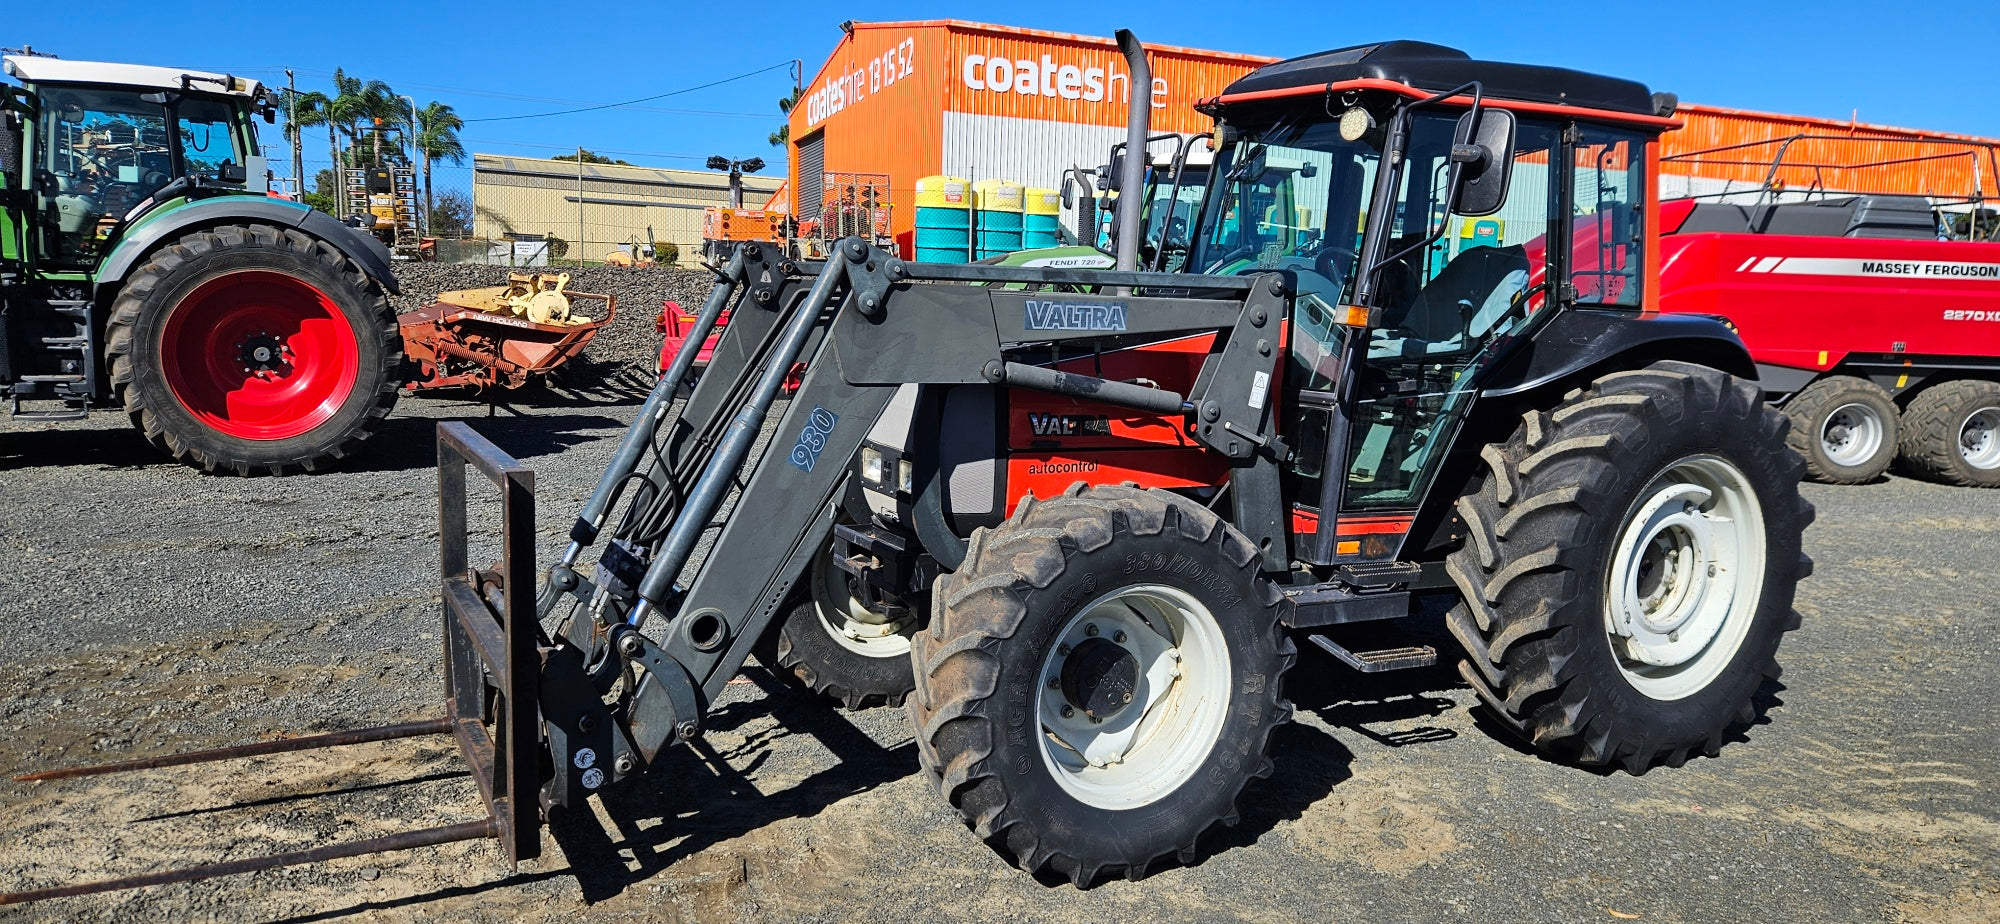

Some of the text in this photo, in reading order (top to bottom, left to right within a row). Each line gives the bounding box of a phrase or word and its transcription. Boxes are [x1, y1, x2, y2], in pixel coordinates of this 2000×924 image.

[868, 57, 881, 95] 13
[882, 47, 896, 88] 15
[897, 36, 914, 80] 52
[963, 53, 1169, 109] coateshe
[1862, 262, 1999, 277] MASSEY FERGUSON
[473, 314, 528, 328] NEW HOLLAND
[1025, 300, 1127, 331] VALTRA
[1029, 413, 1111, 436] VALRA
[791, 407, 835, 473] 930
[1028, 459, 1099, 475] autocontrol
